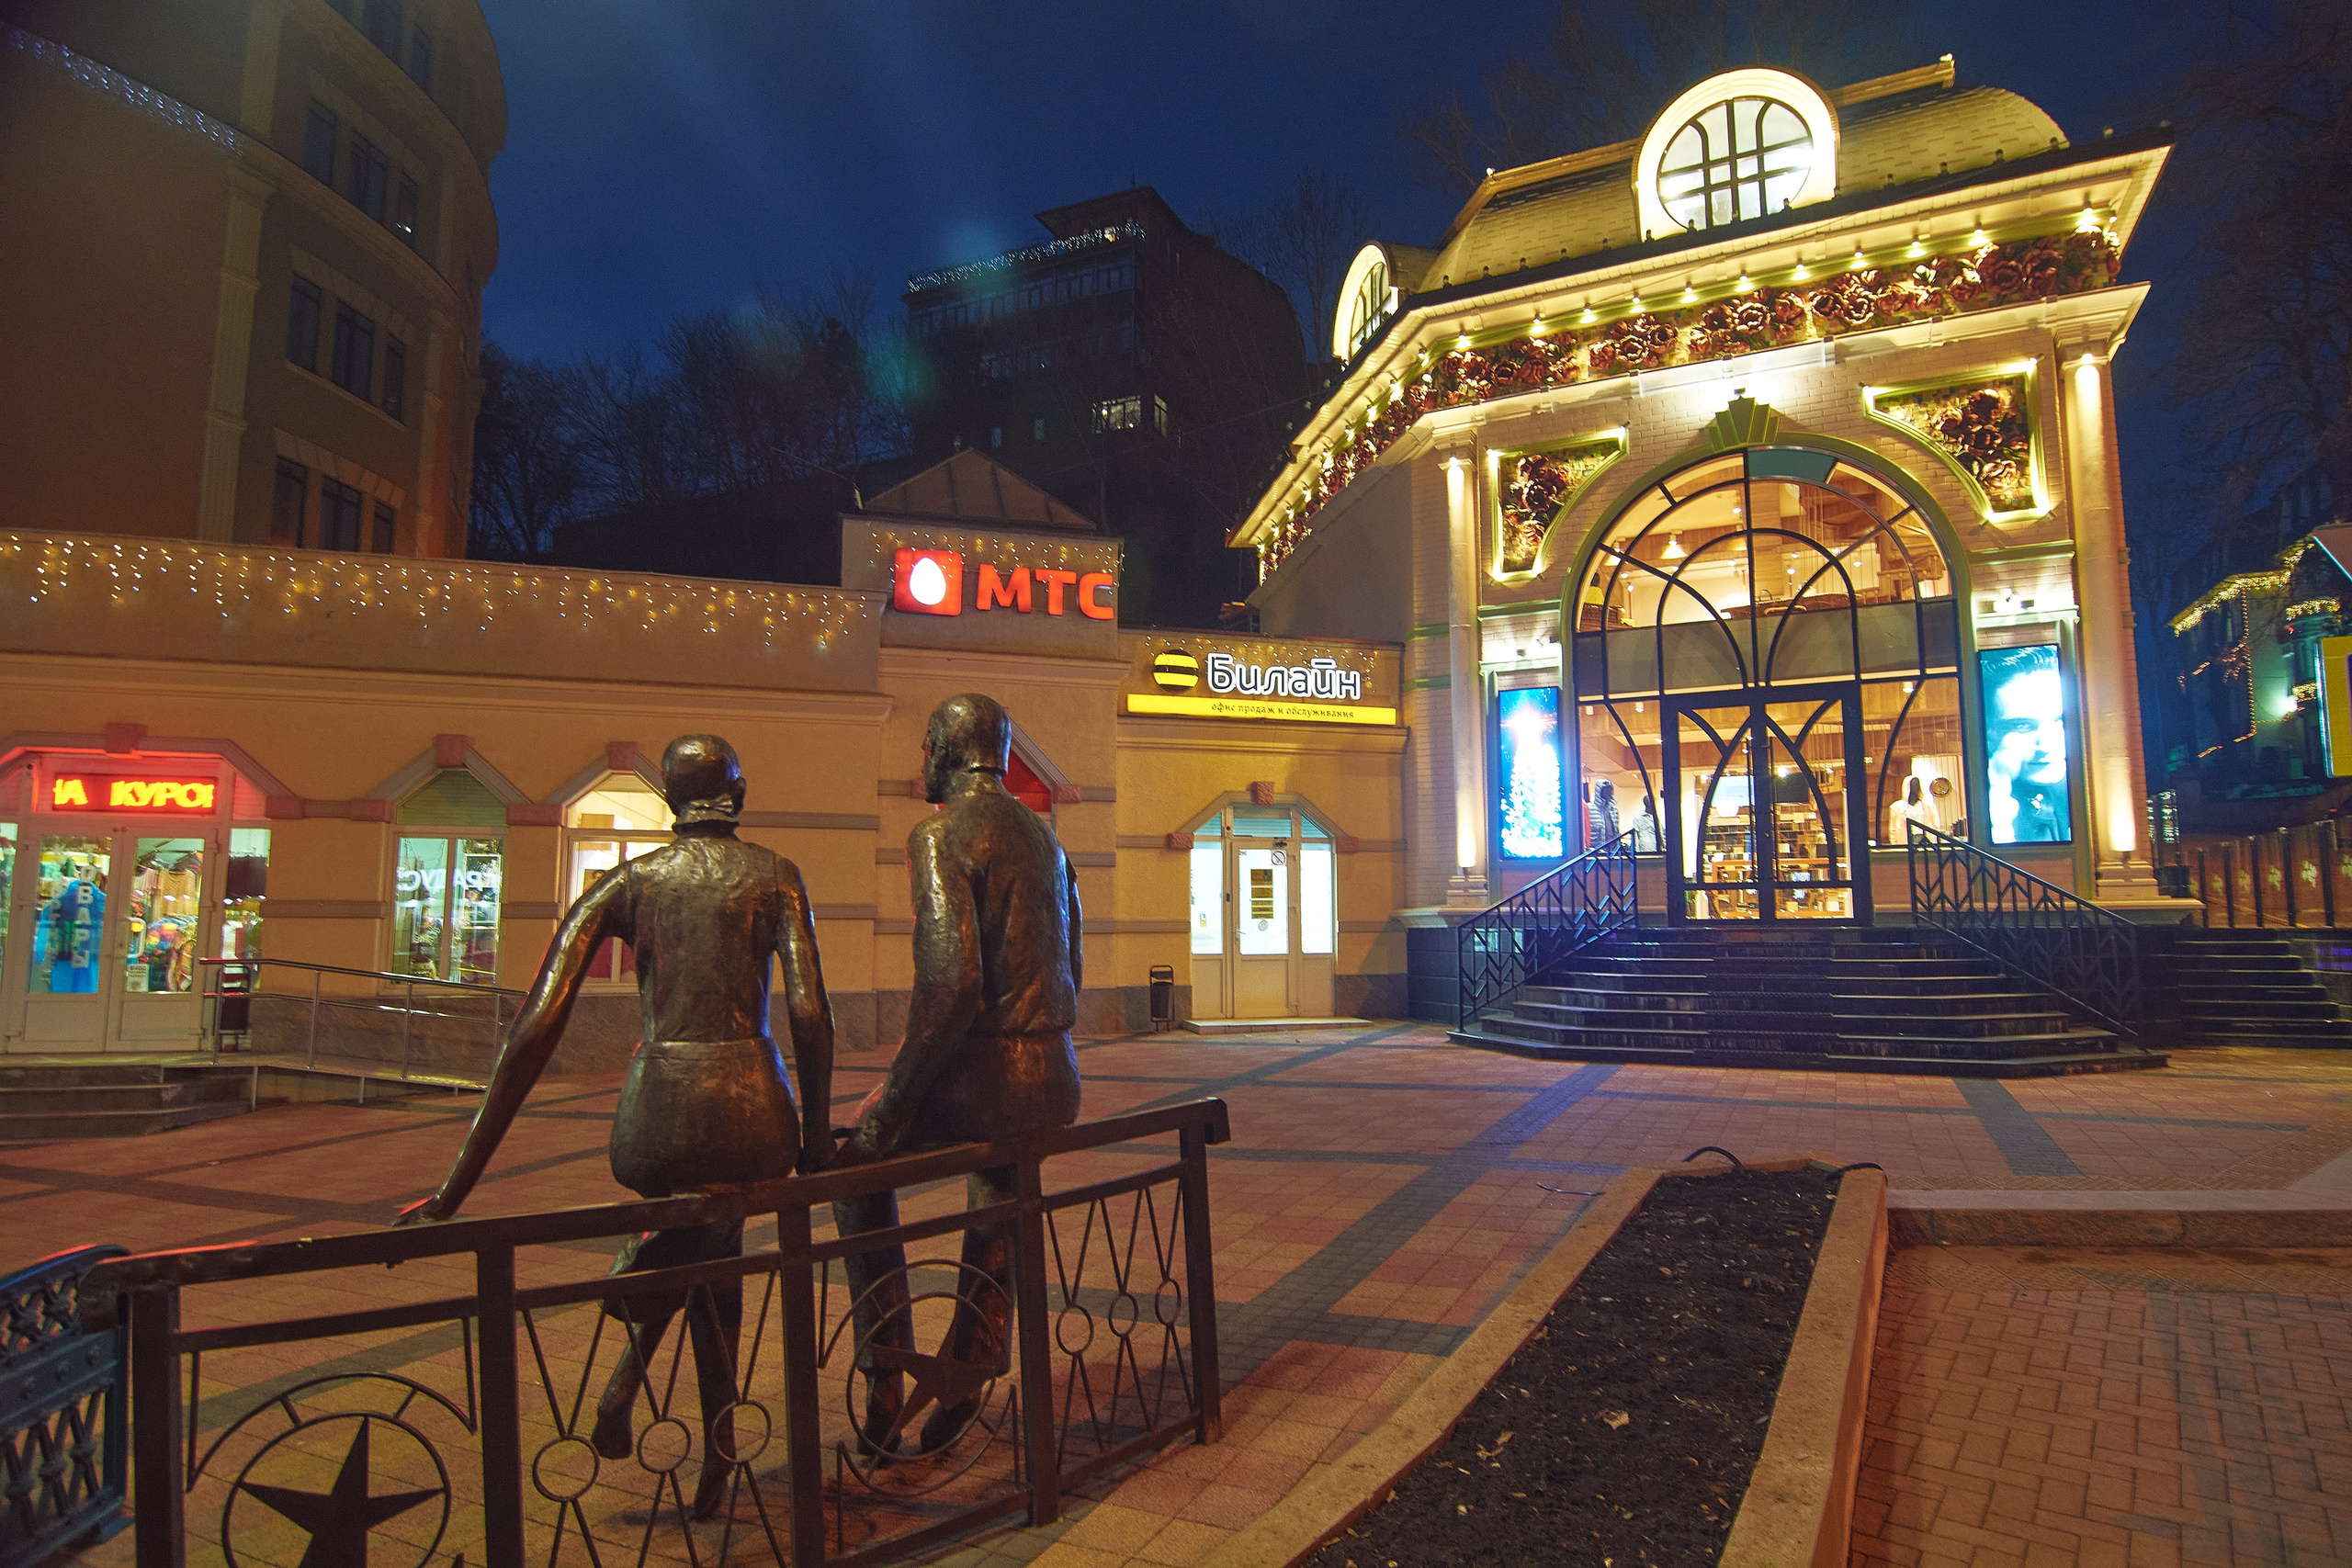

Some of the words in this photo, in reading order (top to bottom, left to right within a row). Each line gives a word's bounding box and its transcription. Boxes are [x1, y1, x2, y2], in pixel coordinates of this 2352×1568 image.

[977, 563, 1114, 620] МТС
[1206, 652, 1362, 700] Билайн
[1211, 702, 1237, 713] офис
[1238, 705, 1275, 716] продаж
[1285, 706, 1355, 718] обслуживания
